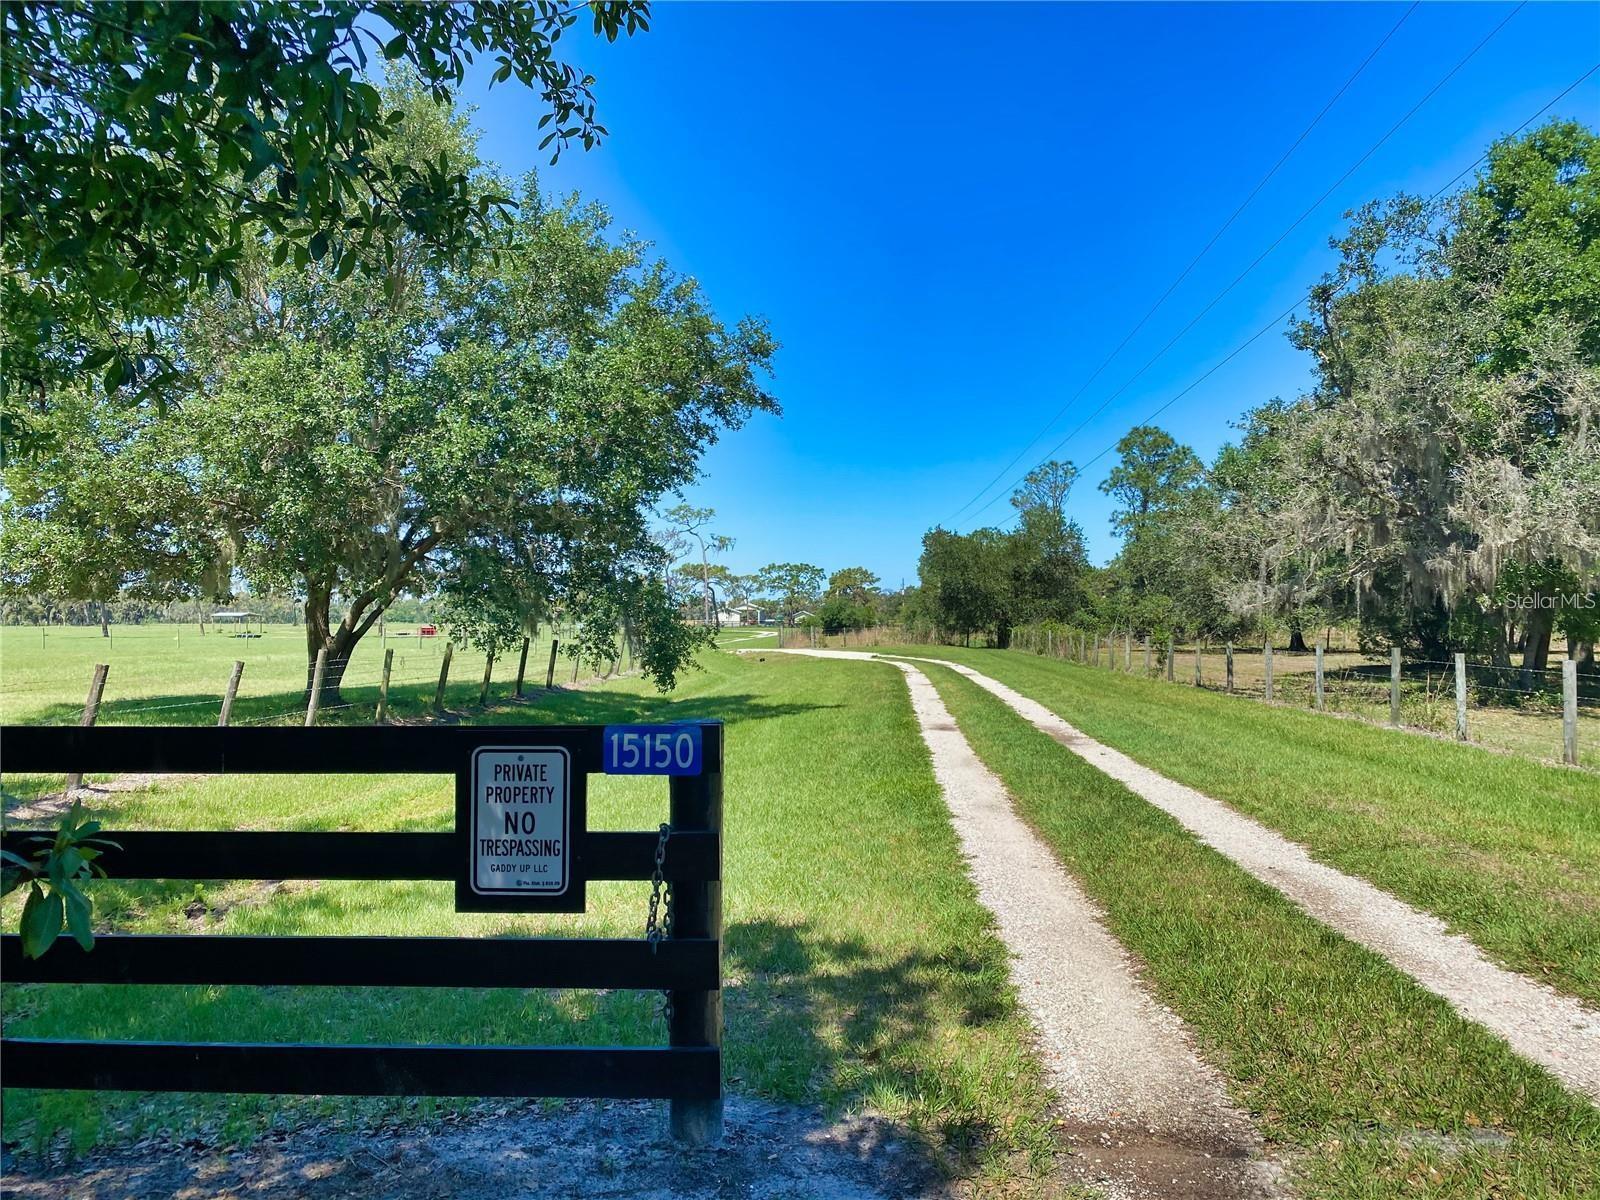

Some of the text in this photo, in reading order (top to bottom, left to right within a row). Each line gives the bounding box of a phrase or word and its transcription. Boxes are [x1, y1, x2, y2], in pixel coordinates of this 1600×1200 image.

[611, 733, 694, 769] 15150
[494, 764, 548, 782] PRIVATE
[485, 786, 555, 804] PROPERTY
[504, 811, 536, 835] NO
[479, 839, 561, 857] TRESPASSING
[490, 863, 549, 873] GADDY UP LLC
